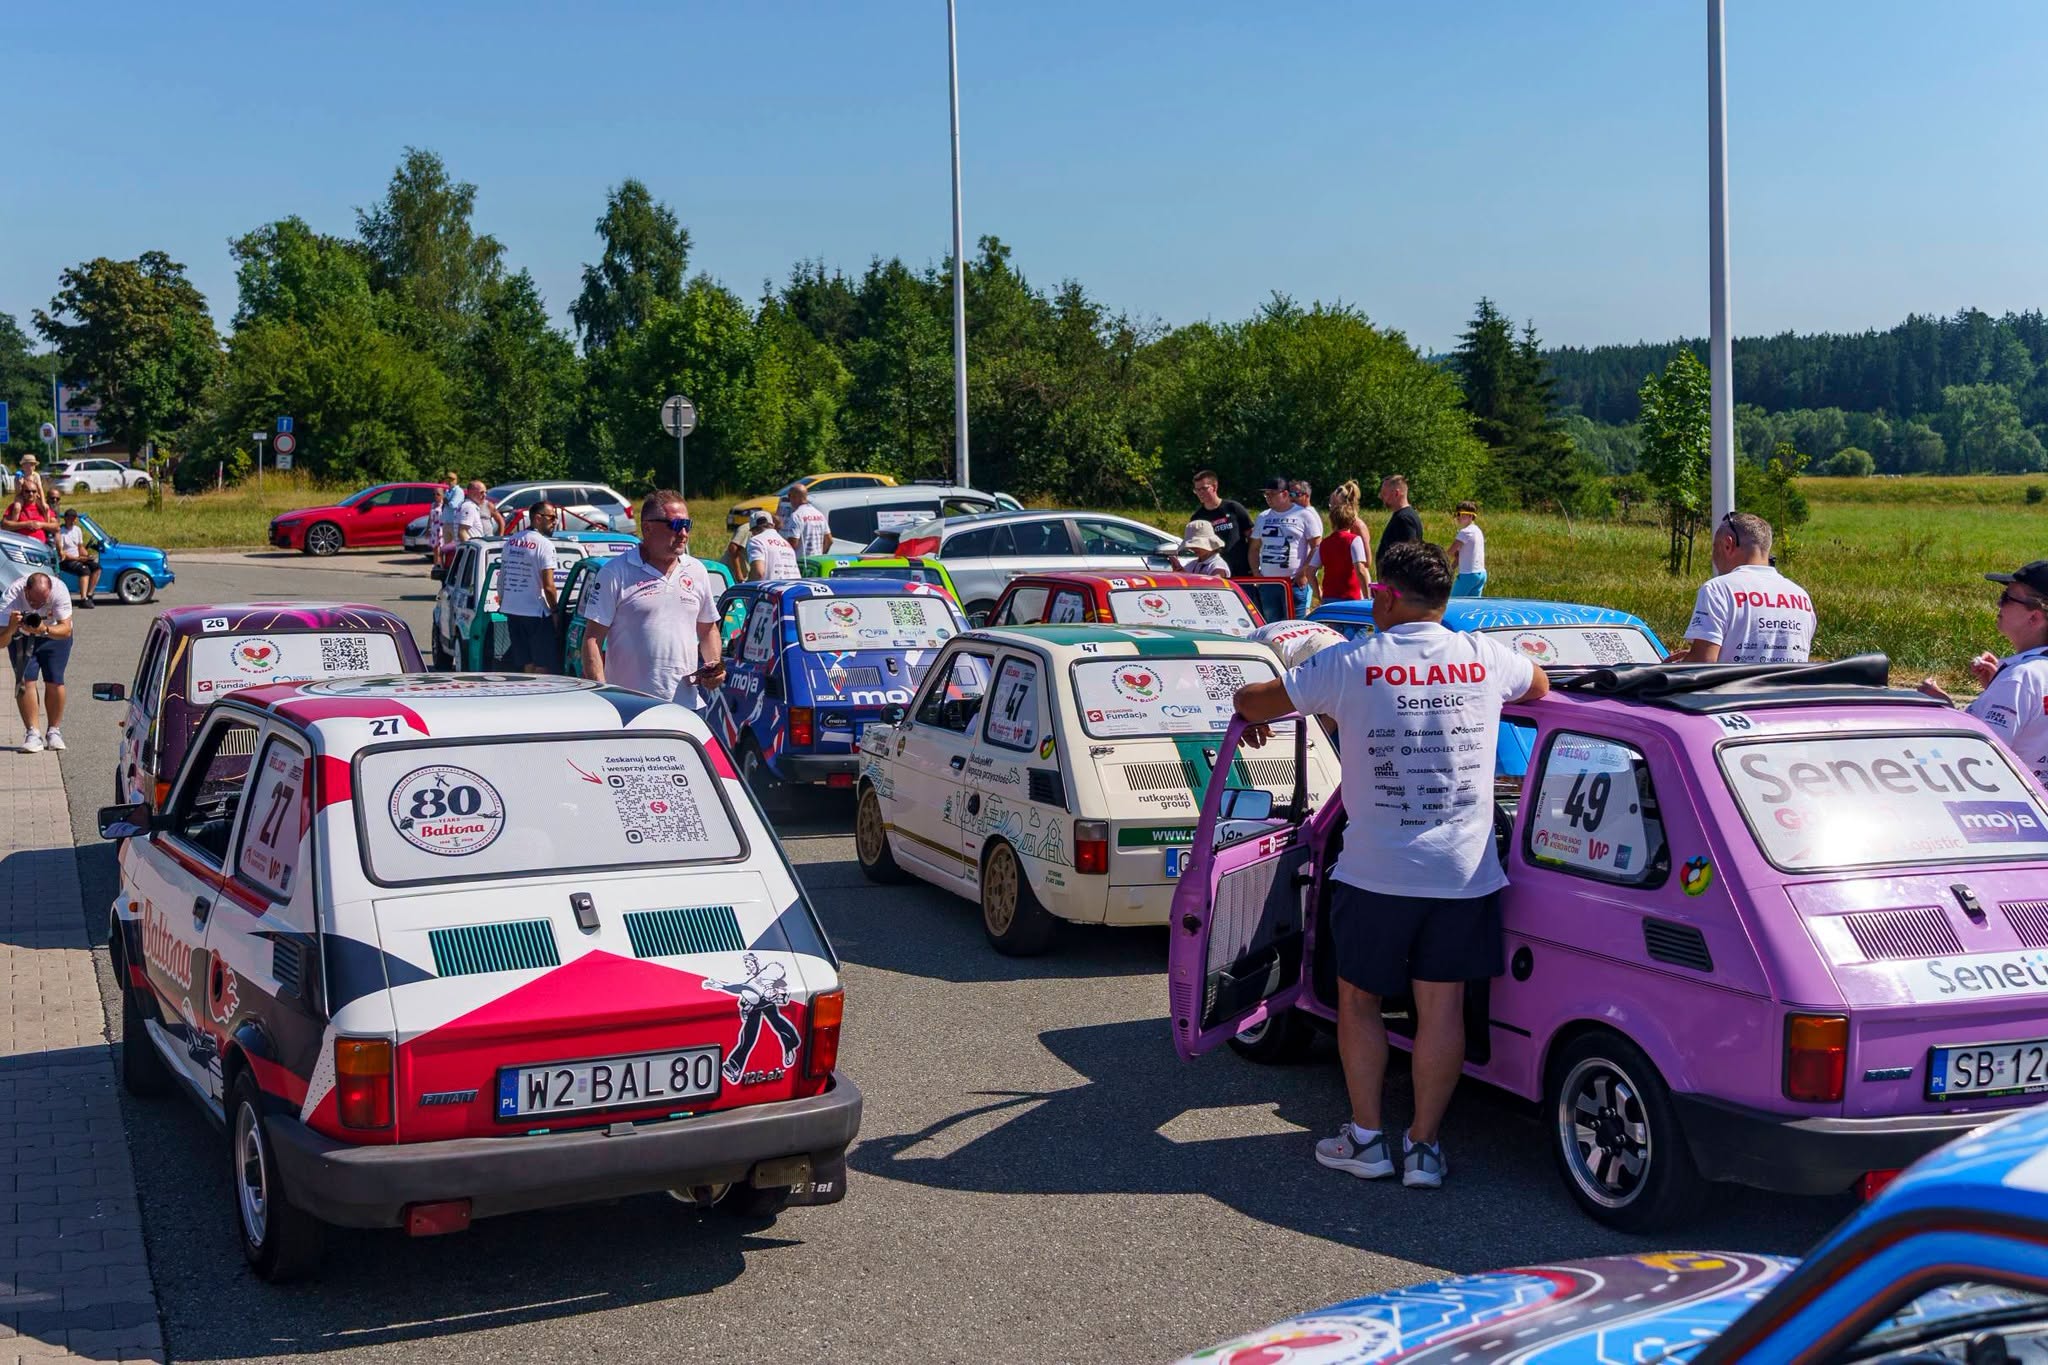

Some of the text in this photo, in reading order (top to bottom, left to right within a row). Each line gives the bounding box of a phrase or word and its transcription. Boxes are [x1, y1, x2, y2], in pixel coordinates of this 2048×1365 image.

[813, 586, 828, 594] 45
[1112, 579, 1126, 588] 42
[1733, 590, 1813, 613] POLAND
[206, 619, 225, 629] 26
[754, 616, 769, 645] 45
[1758, 617, 1801, 631] Senetic
[1081, 644, 1099, 653] 47
[1365, 662, 1487, 687] POLAND
[729, 671, 759, 697] moya
[1004, 682, 1030, 722] 47
[1396, 694, 1465, 709] Senetic
[1106, 712, 1148, 721] Fundacja
[1722, 713, 1752, 731] 49
[368, 718, 400, 736] 27
[1404, 729, 1444, 737] Baltona
[663, 755, 677, 763] QR
[1557, 747, 1591, 761] BIELSKO
[607, 765, 646, 773] wesprzyj
[1740, 749, 2001, 804] Senetic
[1374, 784, 1406, 792] rutkowski
[1386, 789, 1406, 797] group
[410, 785, 482, 819] 80
[1138, 792, 1190, 803] rutkowski
[1563, 768, 1612, 833] 49
[1160, 800, 1191, 810] group
[259, 780, 295, 849] 27
[1400, 818, 1427, 827] Jantar
[1961, 809, 2038, 836] moya
[422, 824, 486, 838] Baltona
[1588, 838, 1610, 861] WP
[143, 897, 193, 990] Baltona
[1927, 954, 2048, 993] Seneti
[1954, 1046, 2048, 1088] SB 12
[527, 1053, 713, 1110] W2 BAL80
[1932, 1076, 1945, 1088] PL
[502, 1098, 517, 1109] PL
